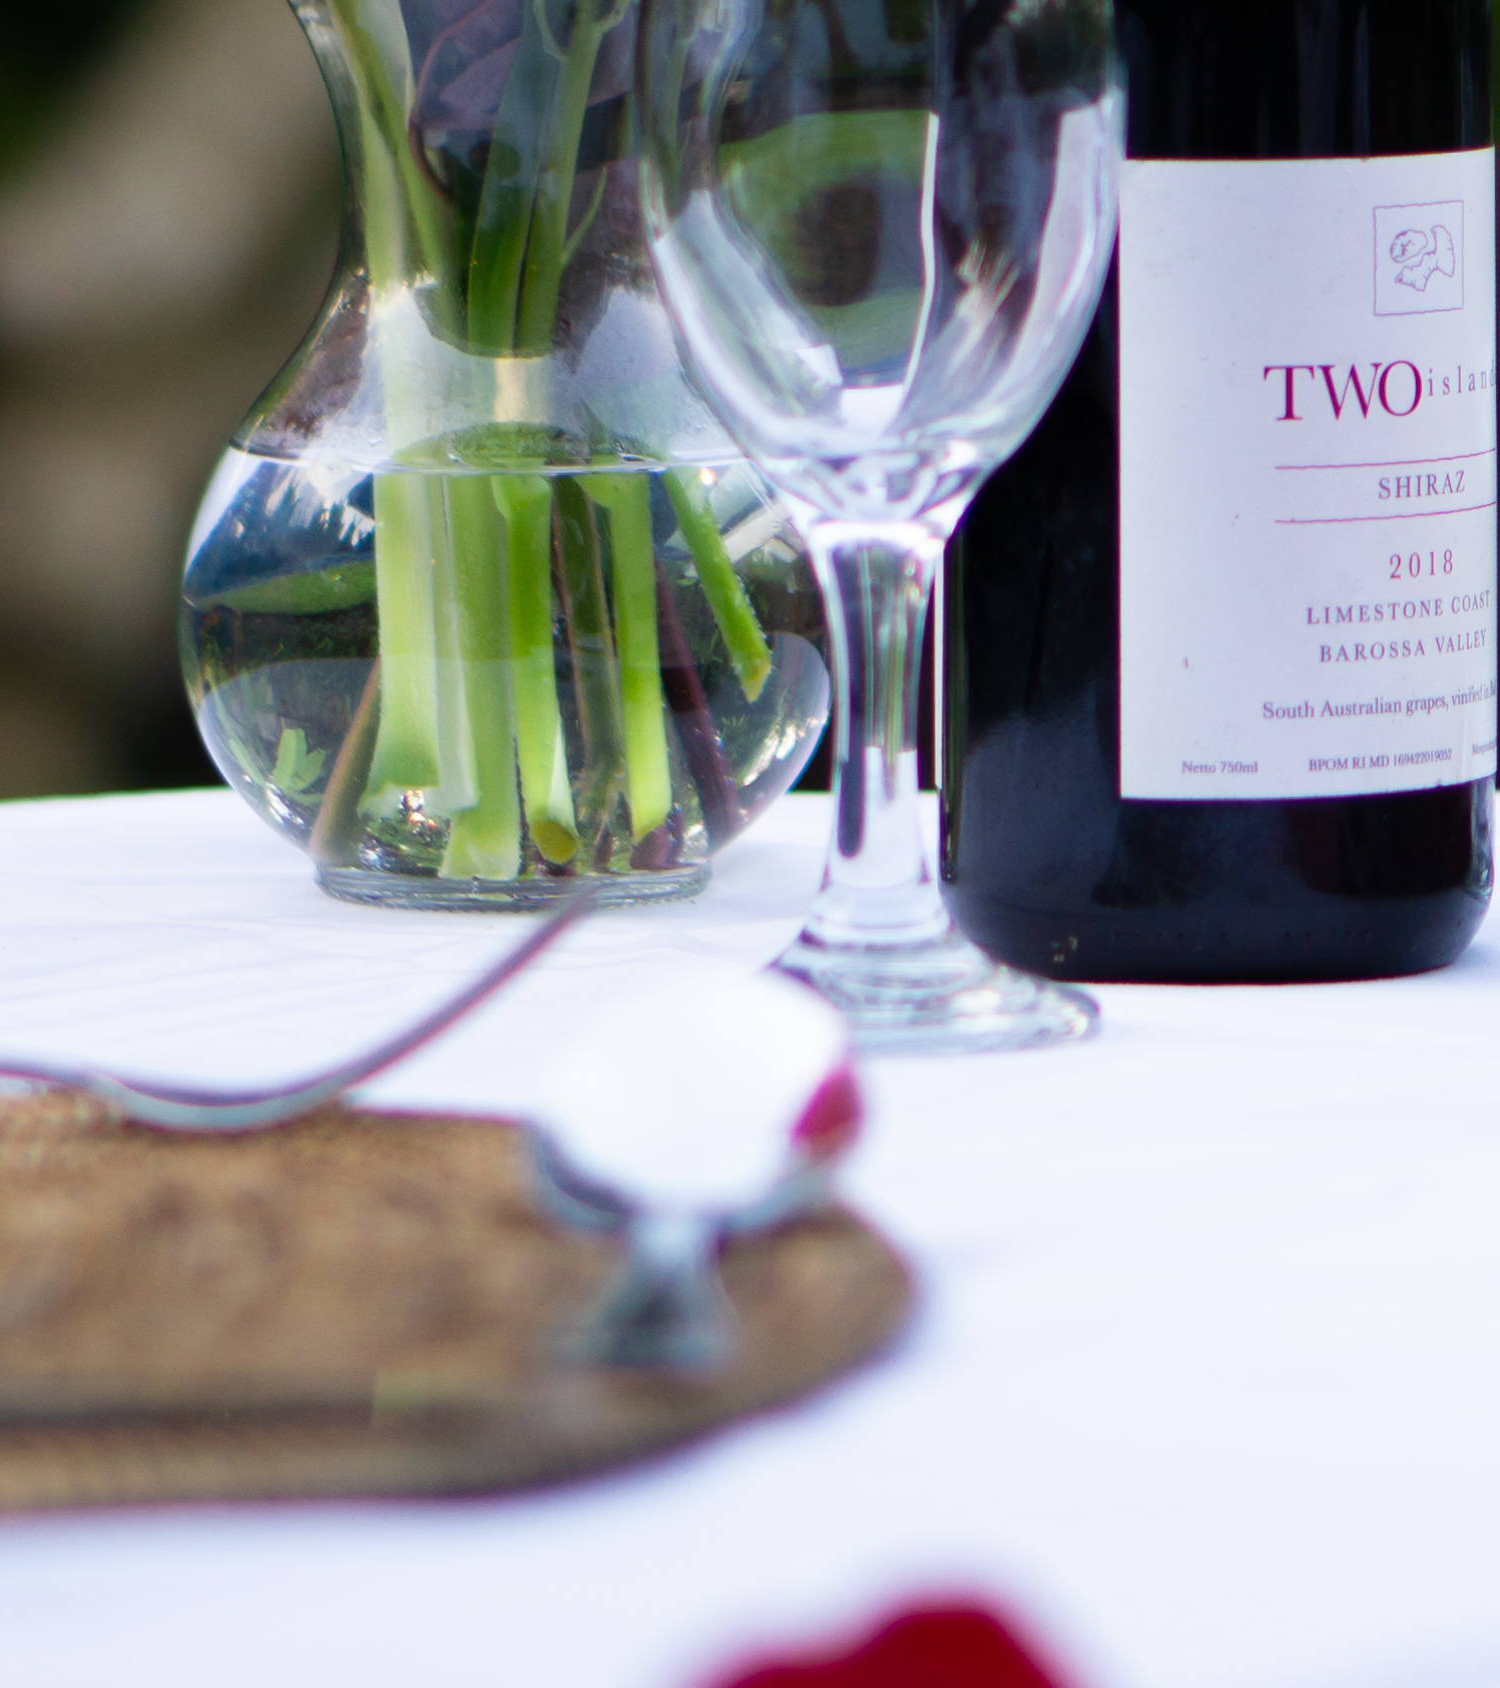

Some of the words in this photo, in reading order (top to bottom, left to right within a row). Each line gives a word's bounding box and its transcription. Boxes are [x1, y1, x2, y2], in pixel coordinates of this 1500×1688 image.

[1262, 359, 1422, 421] TWO
[1428, 359, 1496, 397] island
[1378, 469, 1465, 500] SHIRAZ
[1389, 548, 1453, 580] 2018
[1306, 598, 1444, 625] LIMESTONE
[1451, 589, 1490, 614] COAST
[1318, 639, 1426, 663] BAROSSA
[1435, 628, 1487, 654] VALLEY
[1262, 700, 1315, 719] South
[1320, 696, 1402, 718] Australian
[1406, 695, 1449, 717] grapes,
[1181, 760, 1217, 774] Netto
[1220, 760, 1258, 773] 750ml
[1308, 757, 1349, 772] BPOM
[1352, 756, 1366, 770] RI
[1369, 754, 1390, 768] MD
